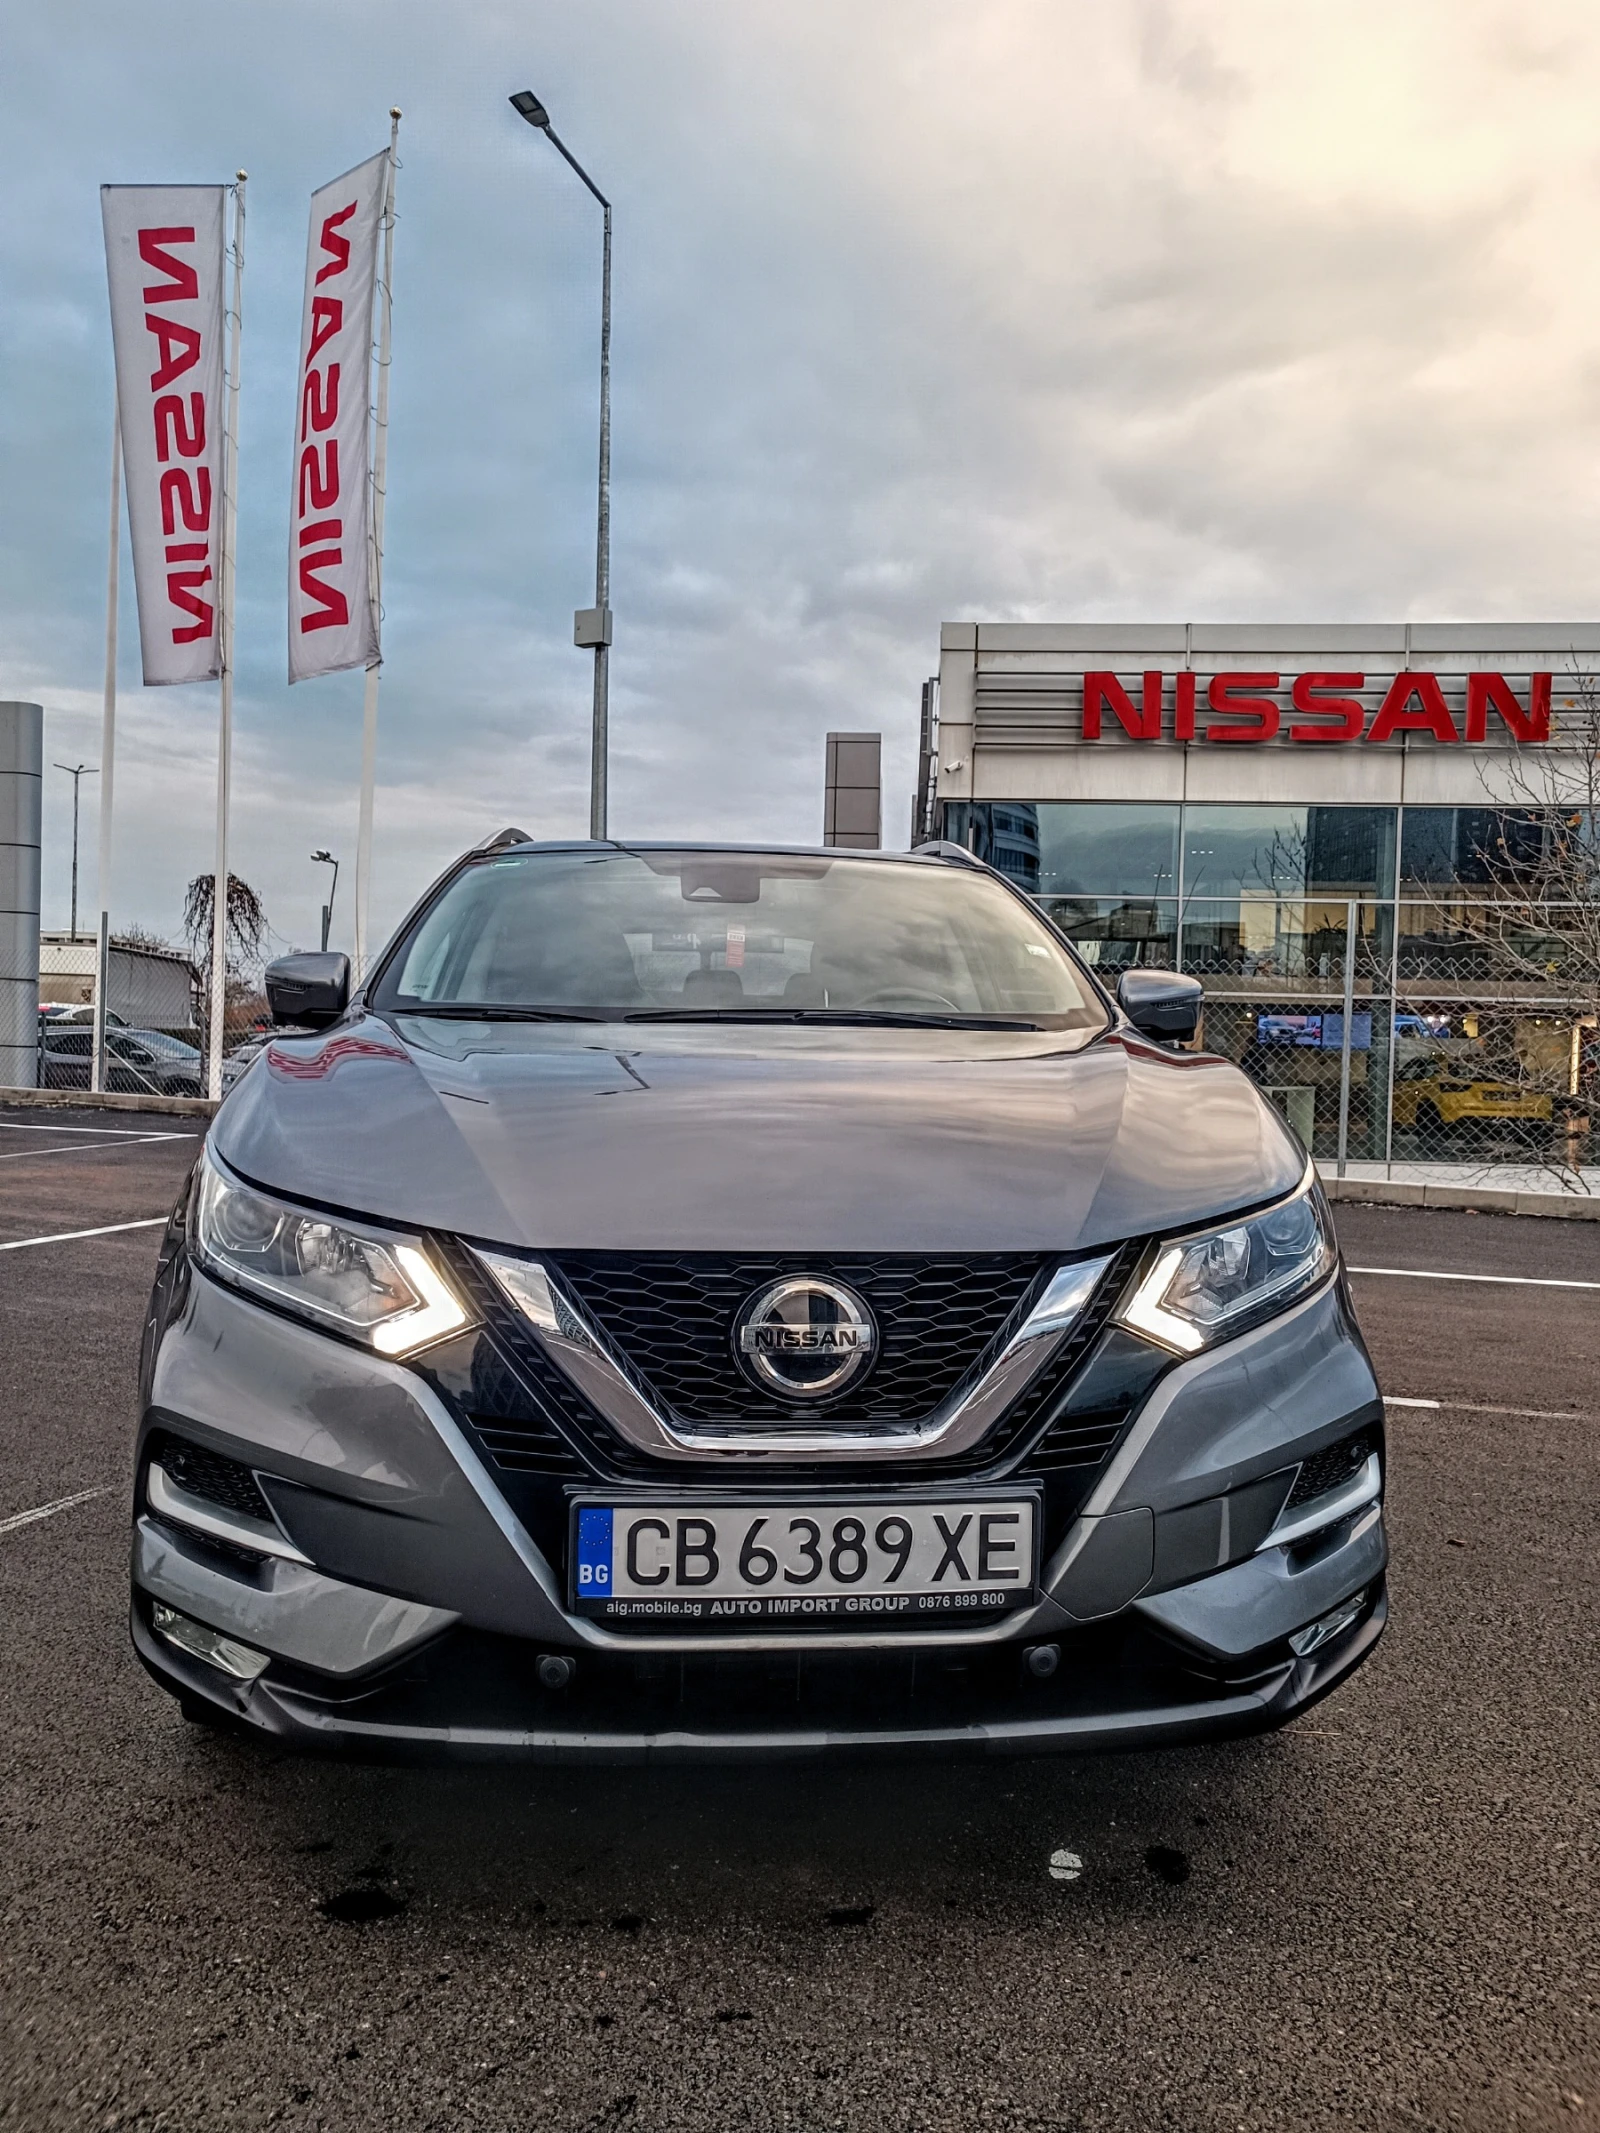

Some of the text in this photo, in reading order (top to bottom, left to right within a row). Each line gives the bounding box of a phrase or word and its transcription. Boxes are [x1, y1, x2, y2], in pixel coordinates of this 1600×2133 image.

[1082, 670, 1553, 743] NISSAN
[754, 1330, 857, 1348] NISSAN
[626, 1513, 1020, 1586] CB 6389 XE
[579, 1564, 609, 1584] BG
[606, 1592, 1005, 1615] aig.mobile.bg AUTO IMPORT GROUP 0876 899 800
